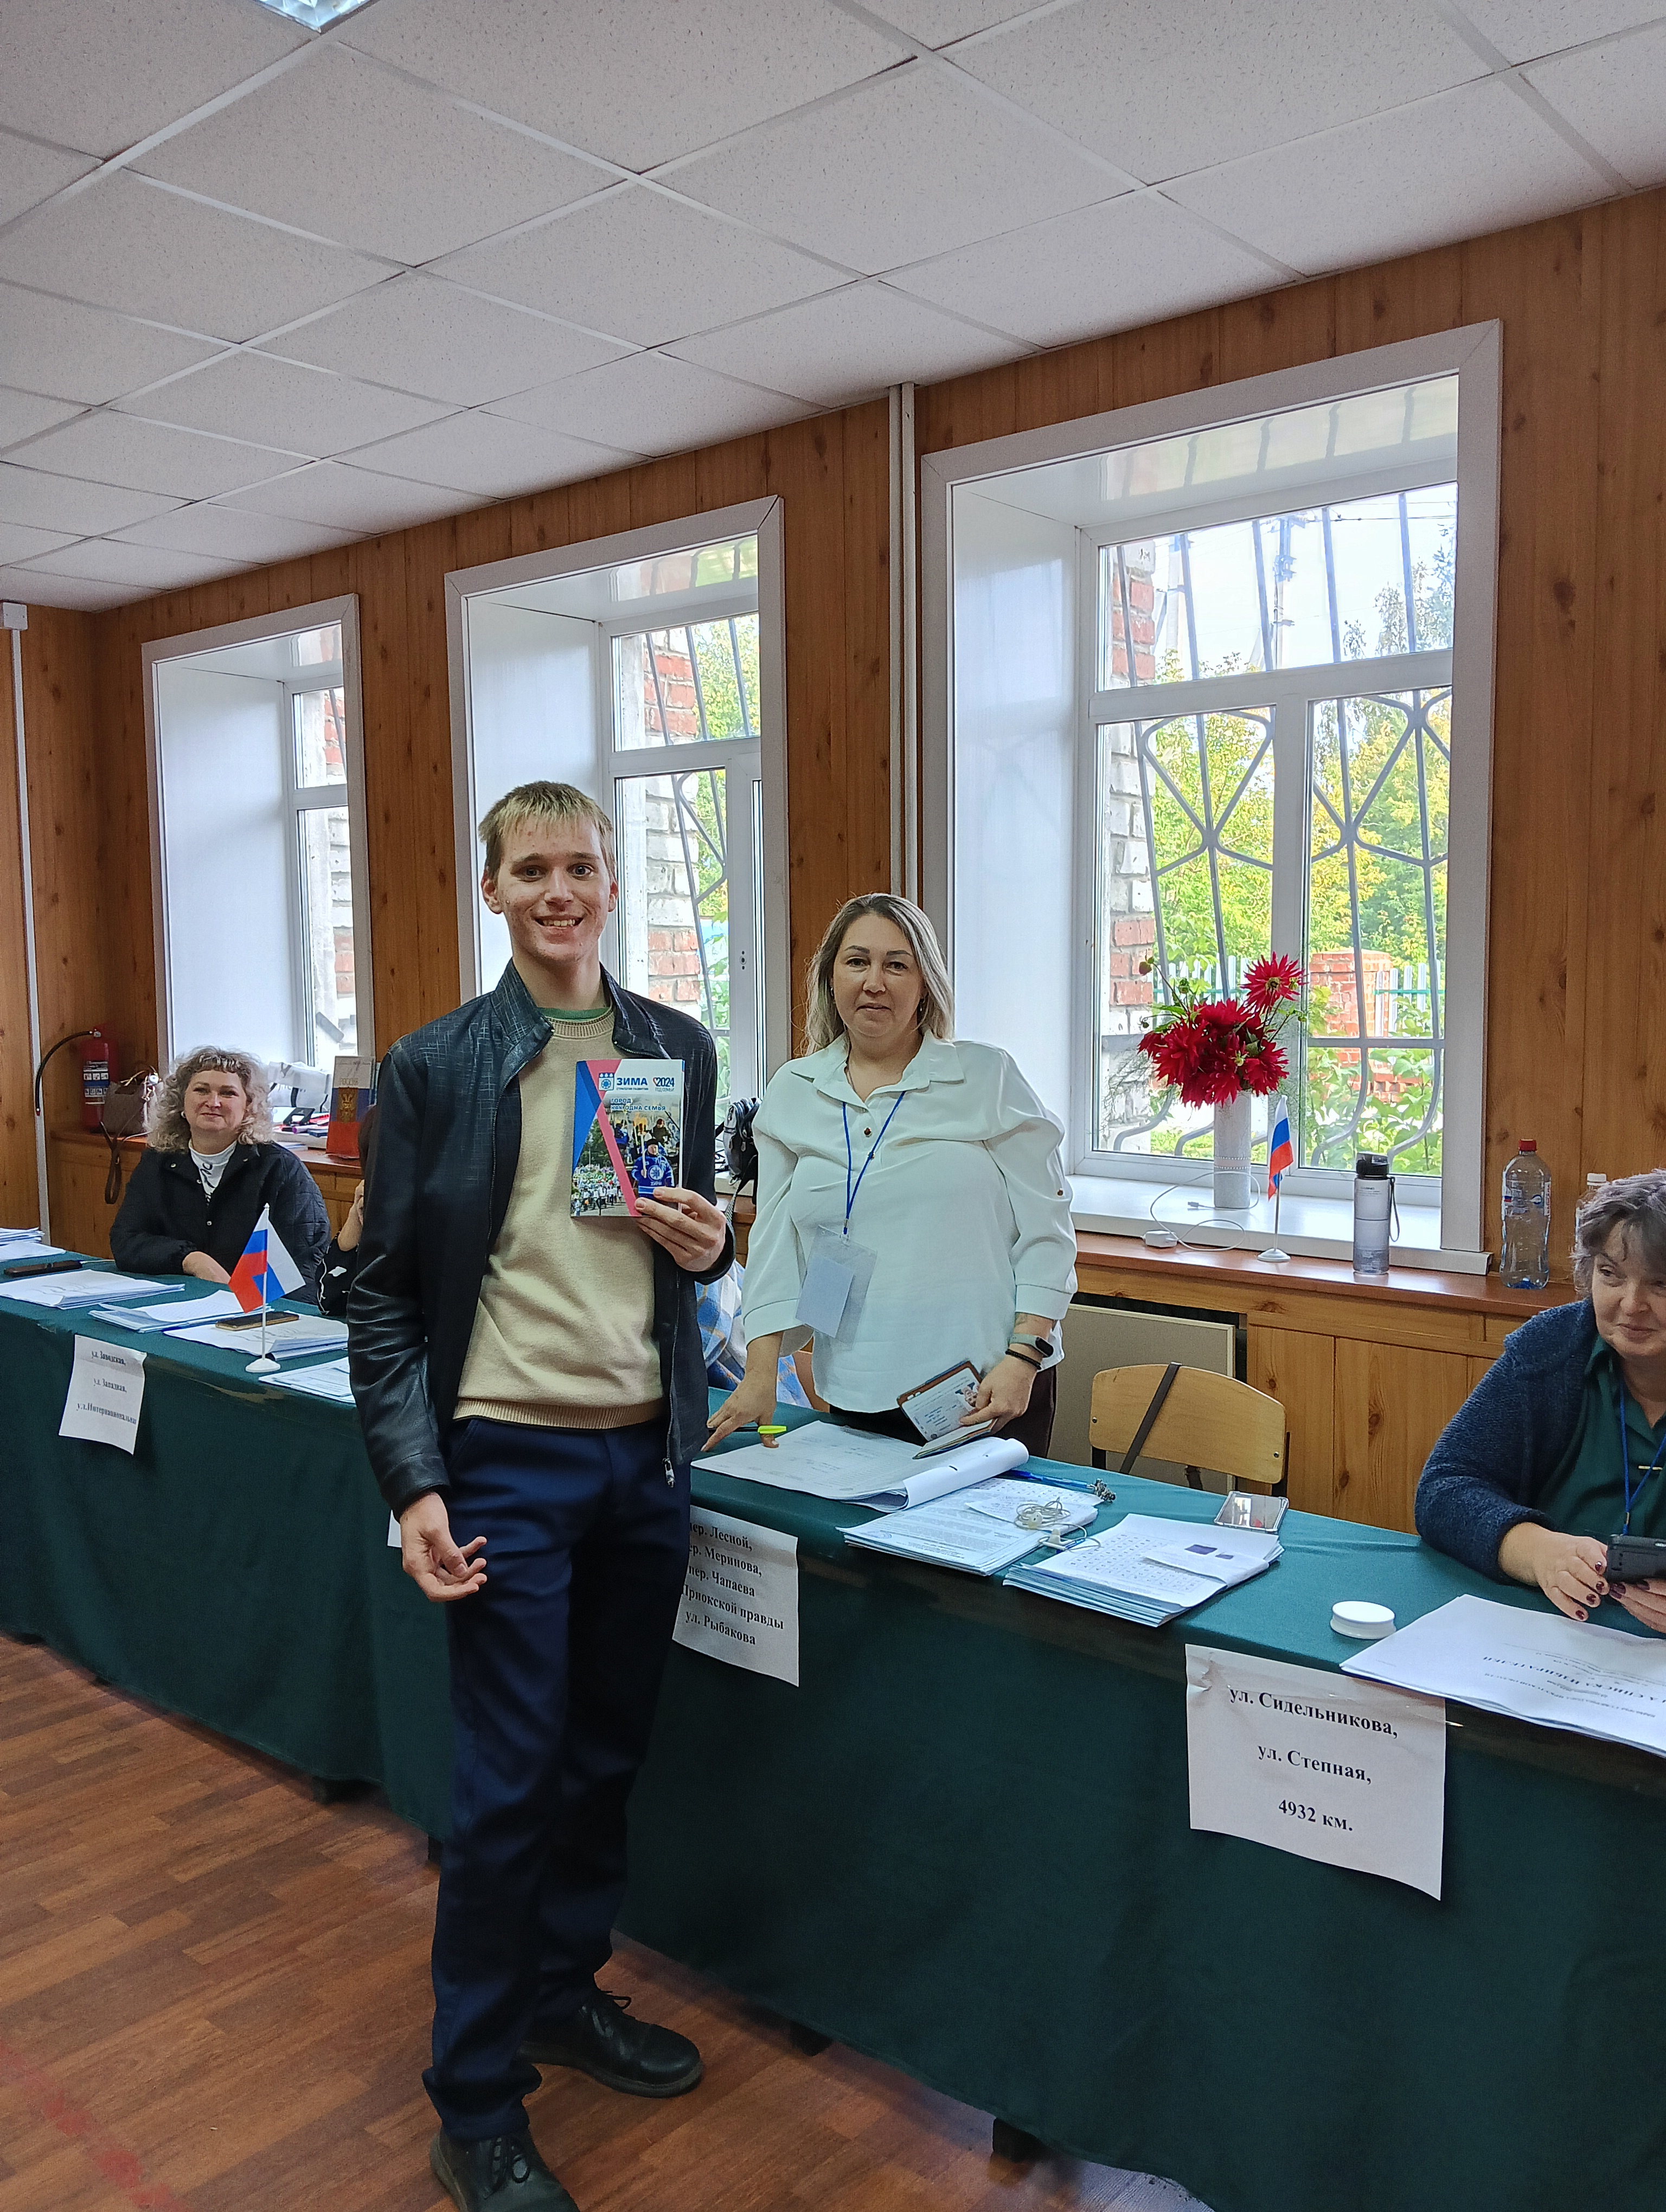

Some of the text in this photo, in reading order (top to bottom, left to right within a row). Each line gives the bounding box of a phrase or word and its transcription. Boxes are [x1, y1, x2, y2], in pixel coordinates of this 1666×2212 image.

[656, 1077, 675, 1087] 2024
[710, 1526, 752, 1551] Лесной,
[705, 1546, 762, 1578] Меринова,
[689, 1566, 755, 1597] пер. Чапаева
[685, 1611, 755, 1645] ул. Рыбакова
[740, 1607, 784, 1629] правды
[1229, 1688, 1398, 1739] ул. Сидельникова,
[1258, 1745, 1372, 1785] ул. Степная,
[1279, 1799, 1353, 1831] 4932 км.
